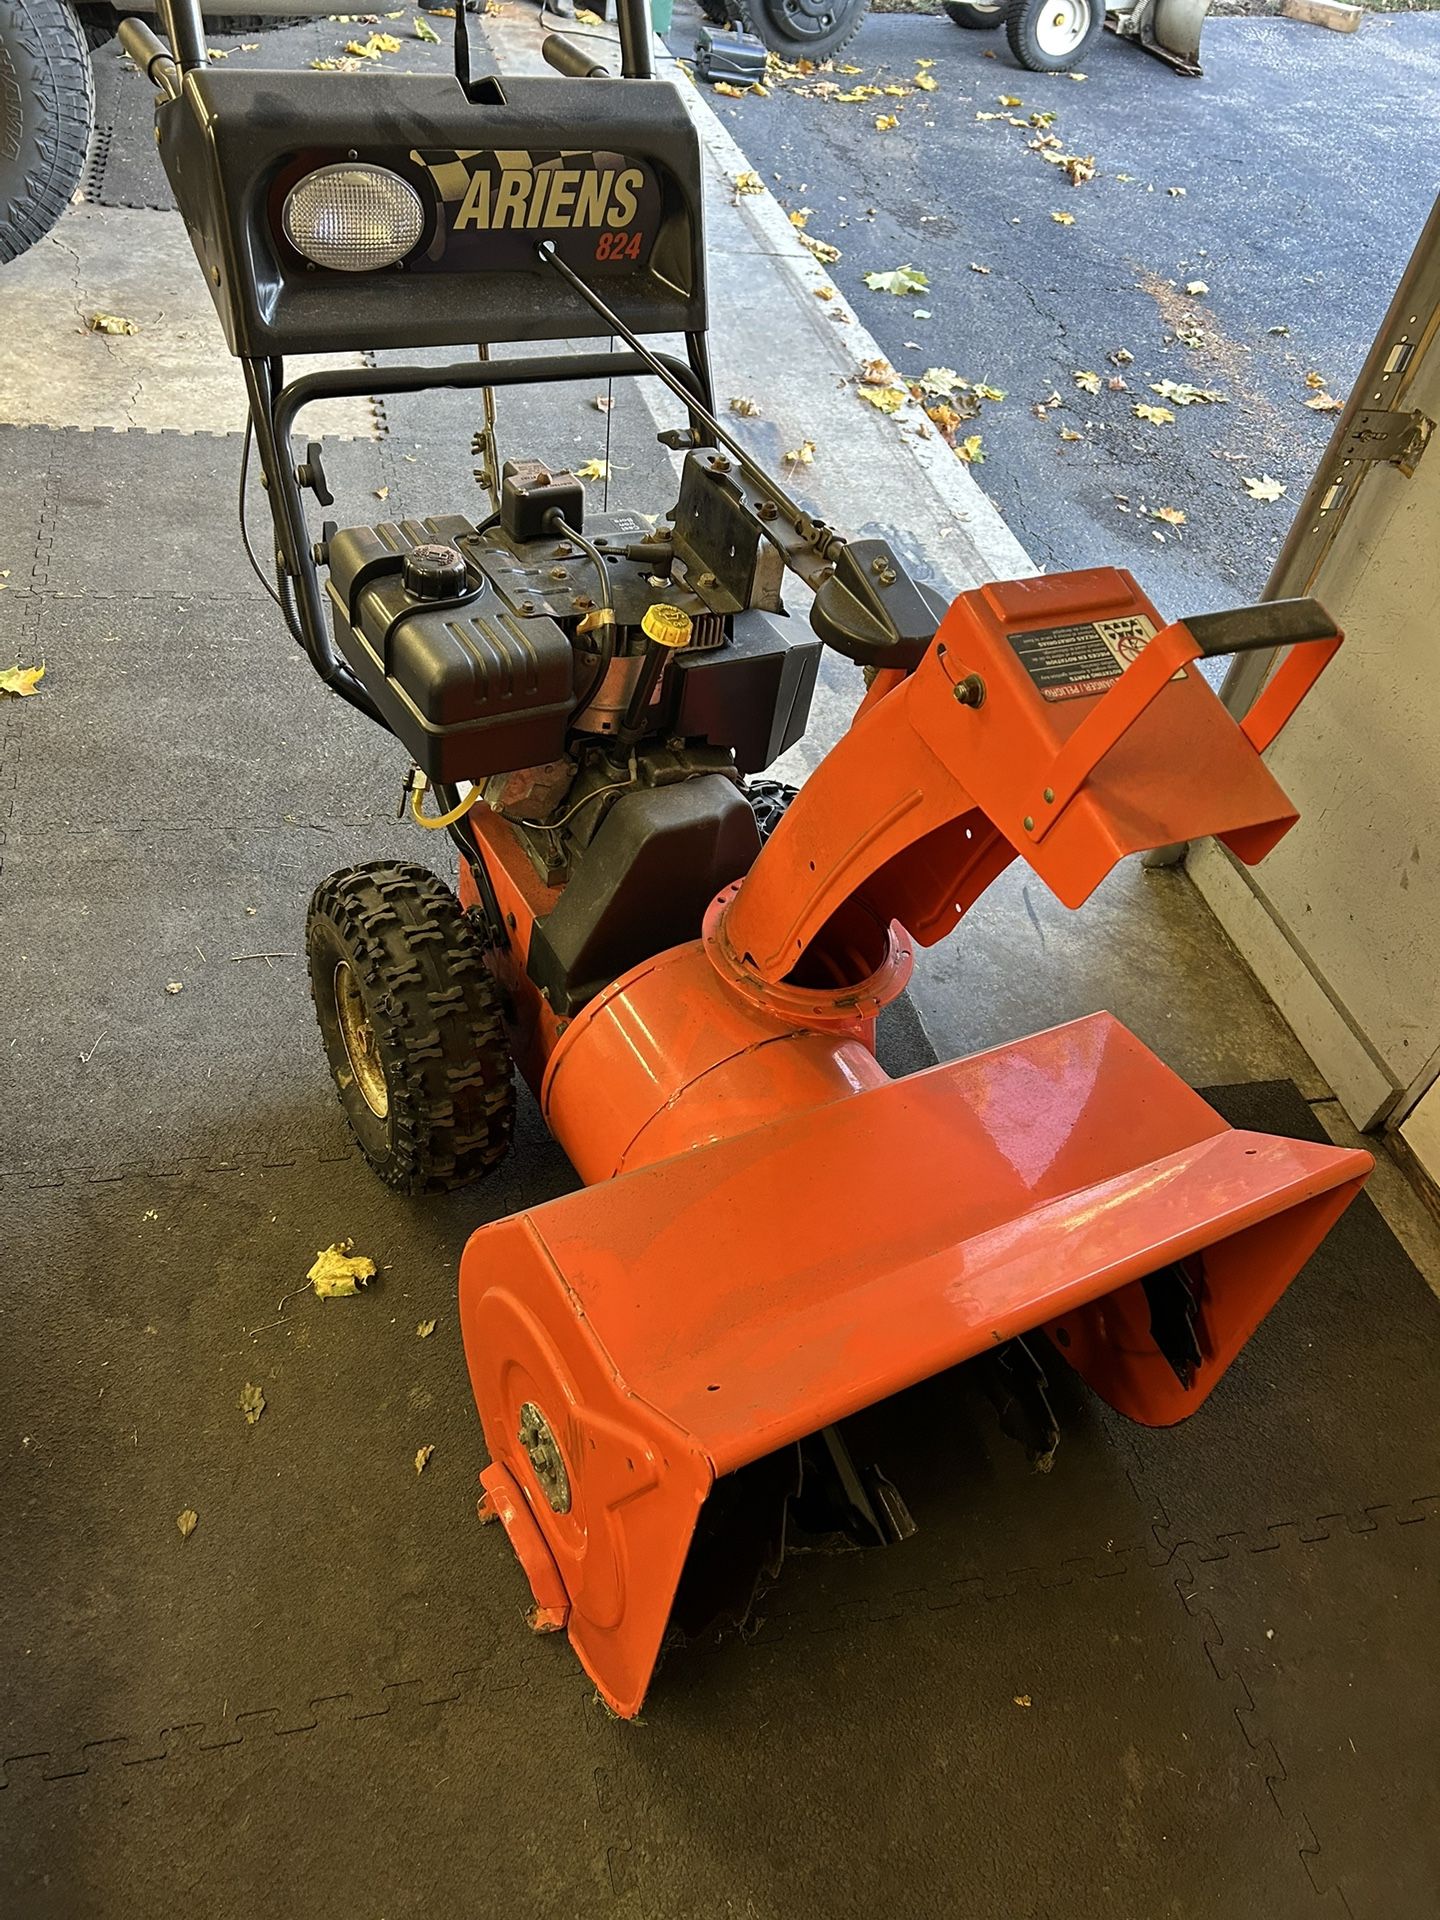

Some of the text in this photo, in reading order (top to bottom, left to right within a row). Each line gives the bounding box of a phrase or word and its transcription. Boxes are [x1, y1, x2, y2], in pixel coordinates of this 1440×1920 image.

[453, 168, 644, 230] ARIENS
[595, 231, 642, 261] 824
[1068, 668, 1122, 681] ROTATING PARTS
[1044, 685, 1080, 697] PELIGRO
